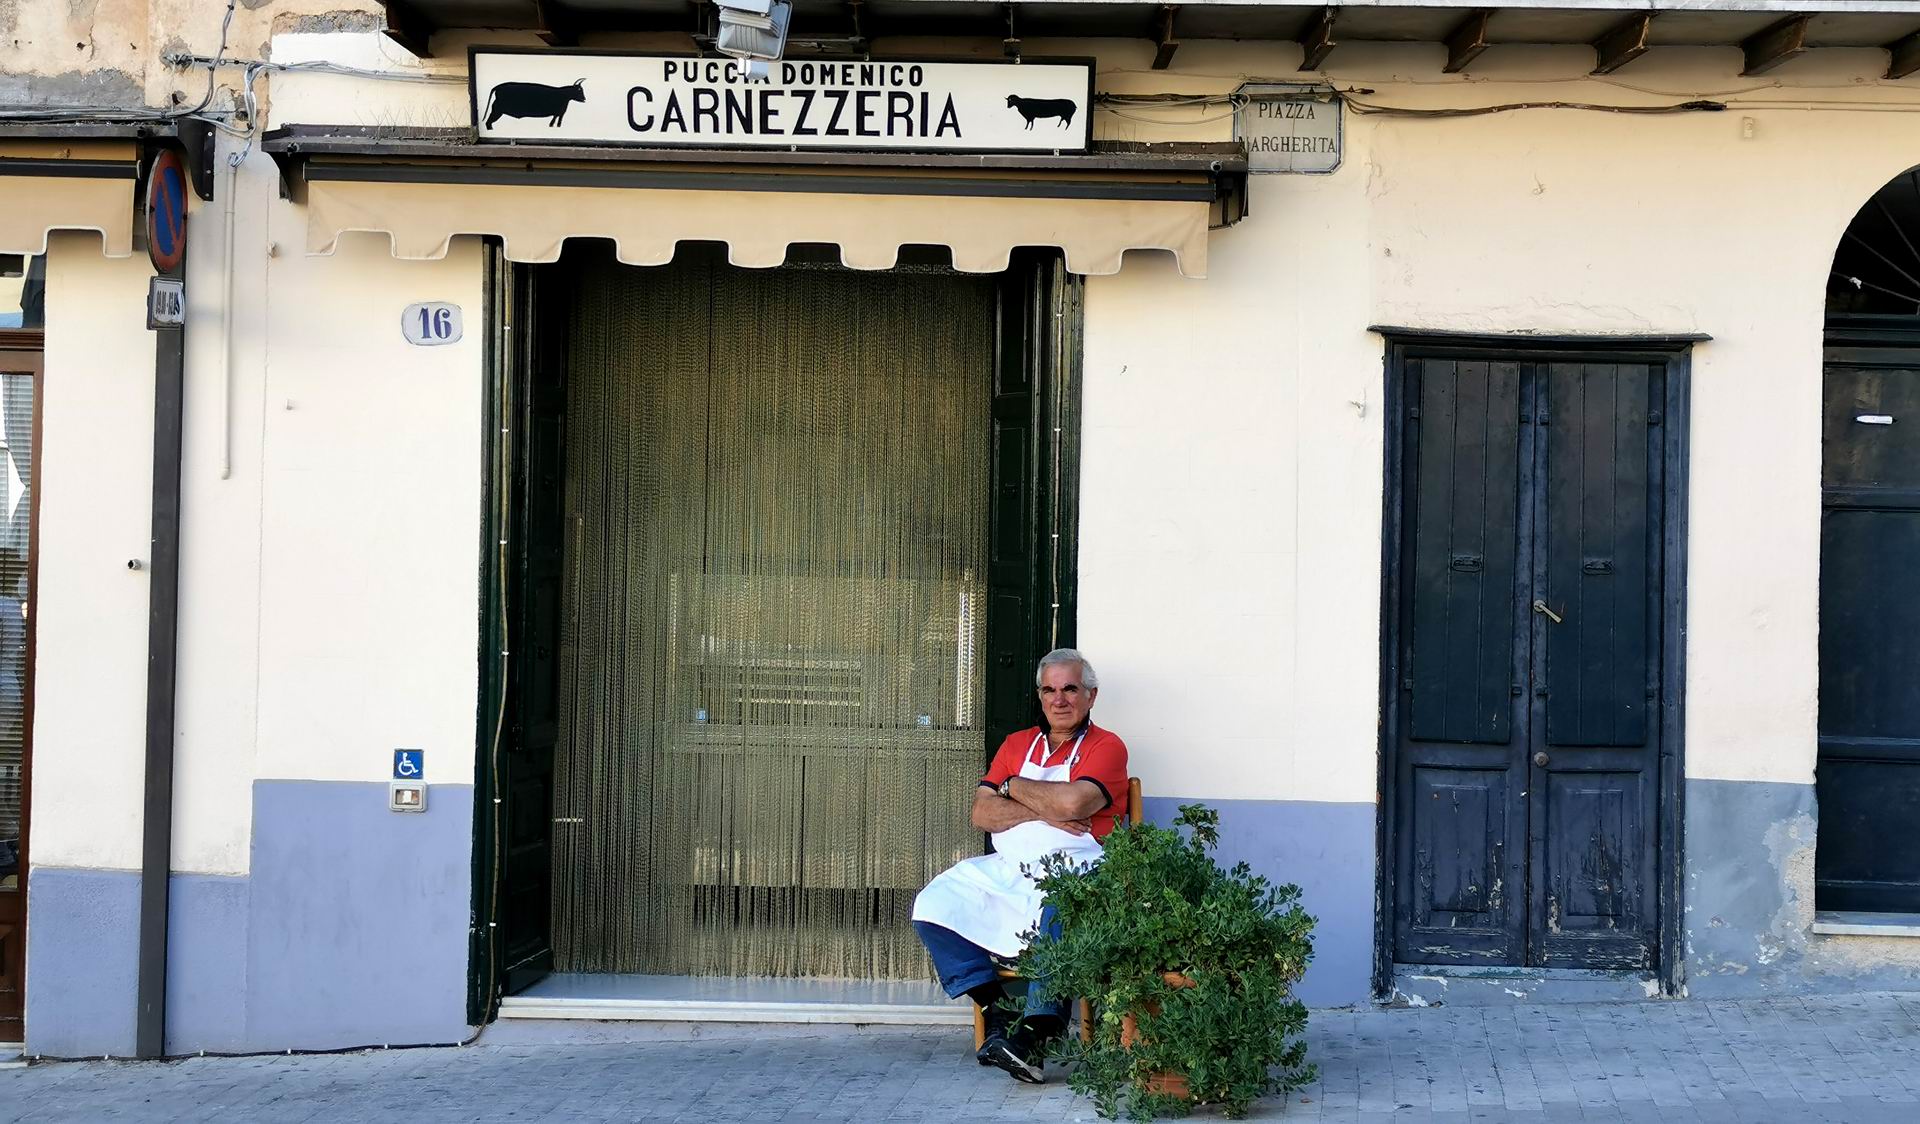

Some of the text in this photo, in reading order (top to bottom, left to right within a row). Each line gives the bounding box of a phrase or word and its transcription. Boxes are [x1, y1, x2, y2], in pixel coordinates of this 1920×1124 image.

[782, 62, 923, 87] DOMENICO
[627, 86, 962, 138] CARNEZZERIA
[1258, 102, 1316, 119] PIAZZA
[418, 305, 452, 339] 16
